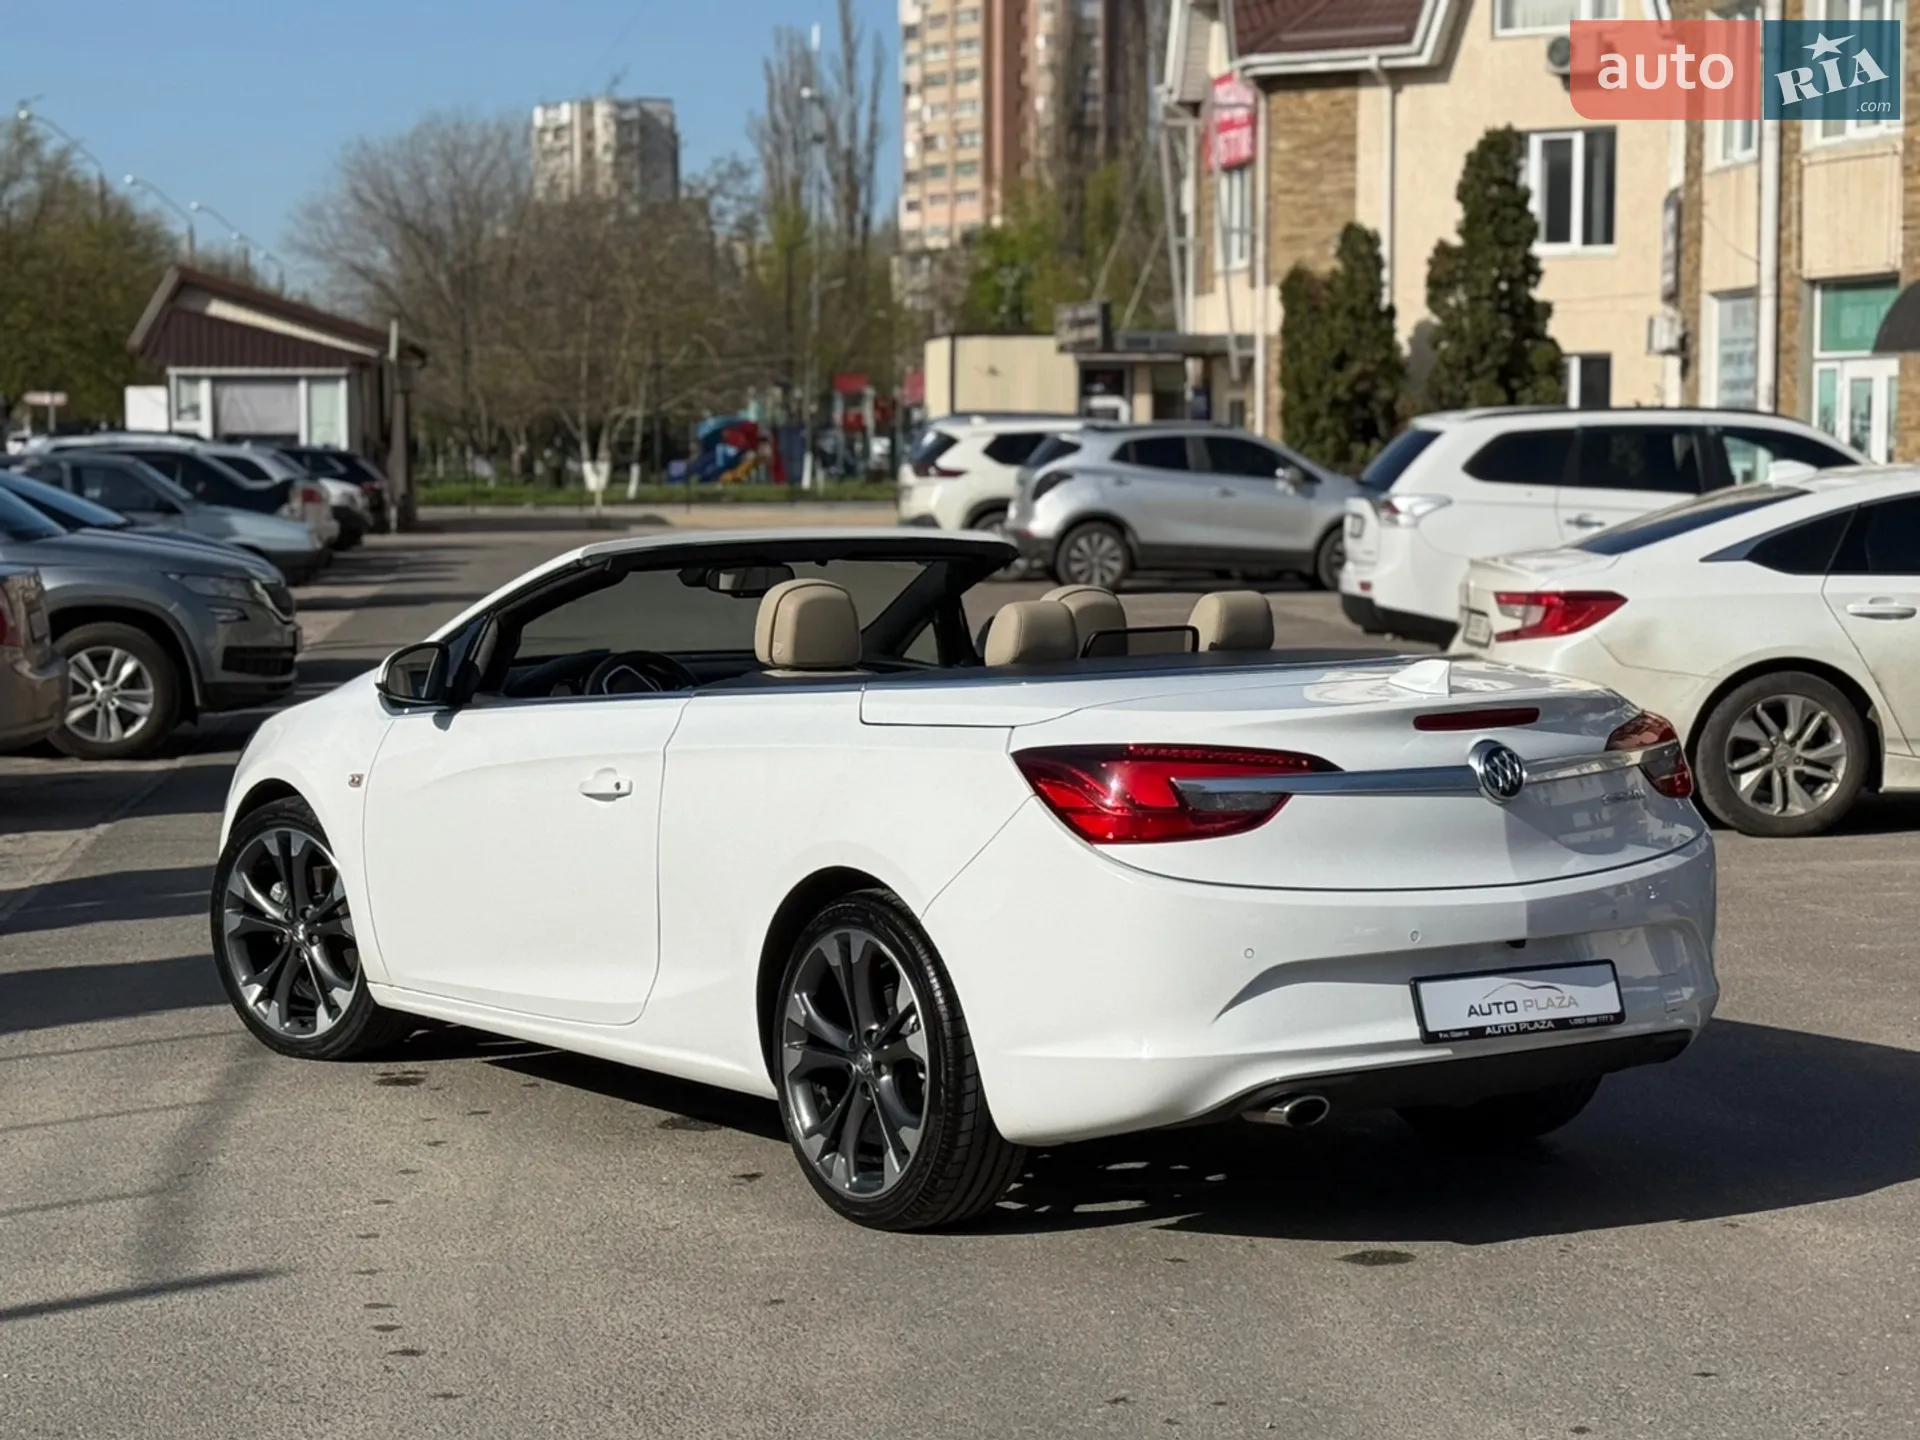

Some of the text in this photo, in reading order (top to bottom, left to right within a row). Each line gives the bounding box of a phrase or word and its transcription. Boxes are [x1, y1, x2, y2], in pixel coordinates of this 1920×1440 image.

[1468, 995, 1579, 1018] AUTO PLAZA
[1485, 1020, 1555, 1036] AUTO PLAZA
